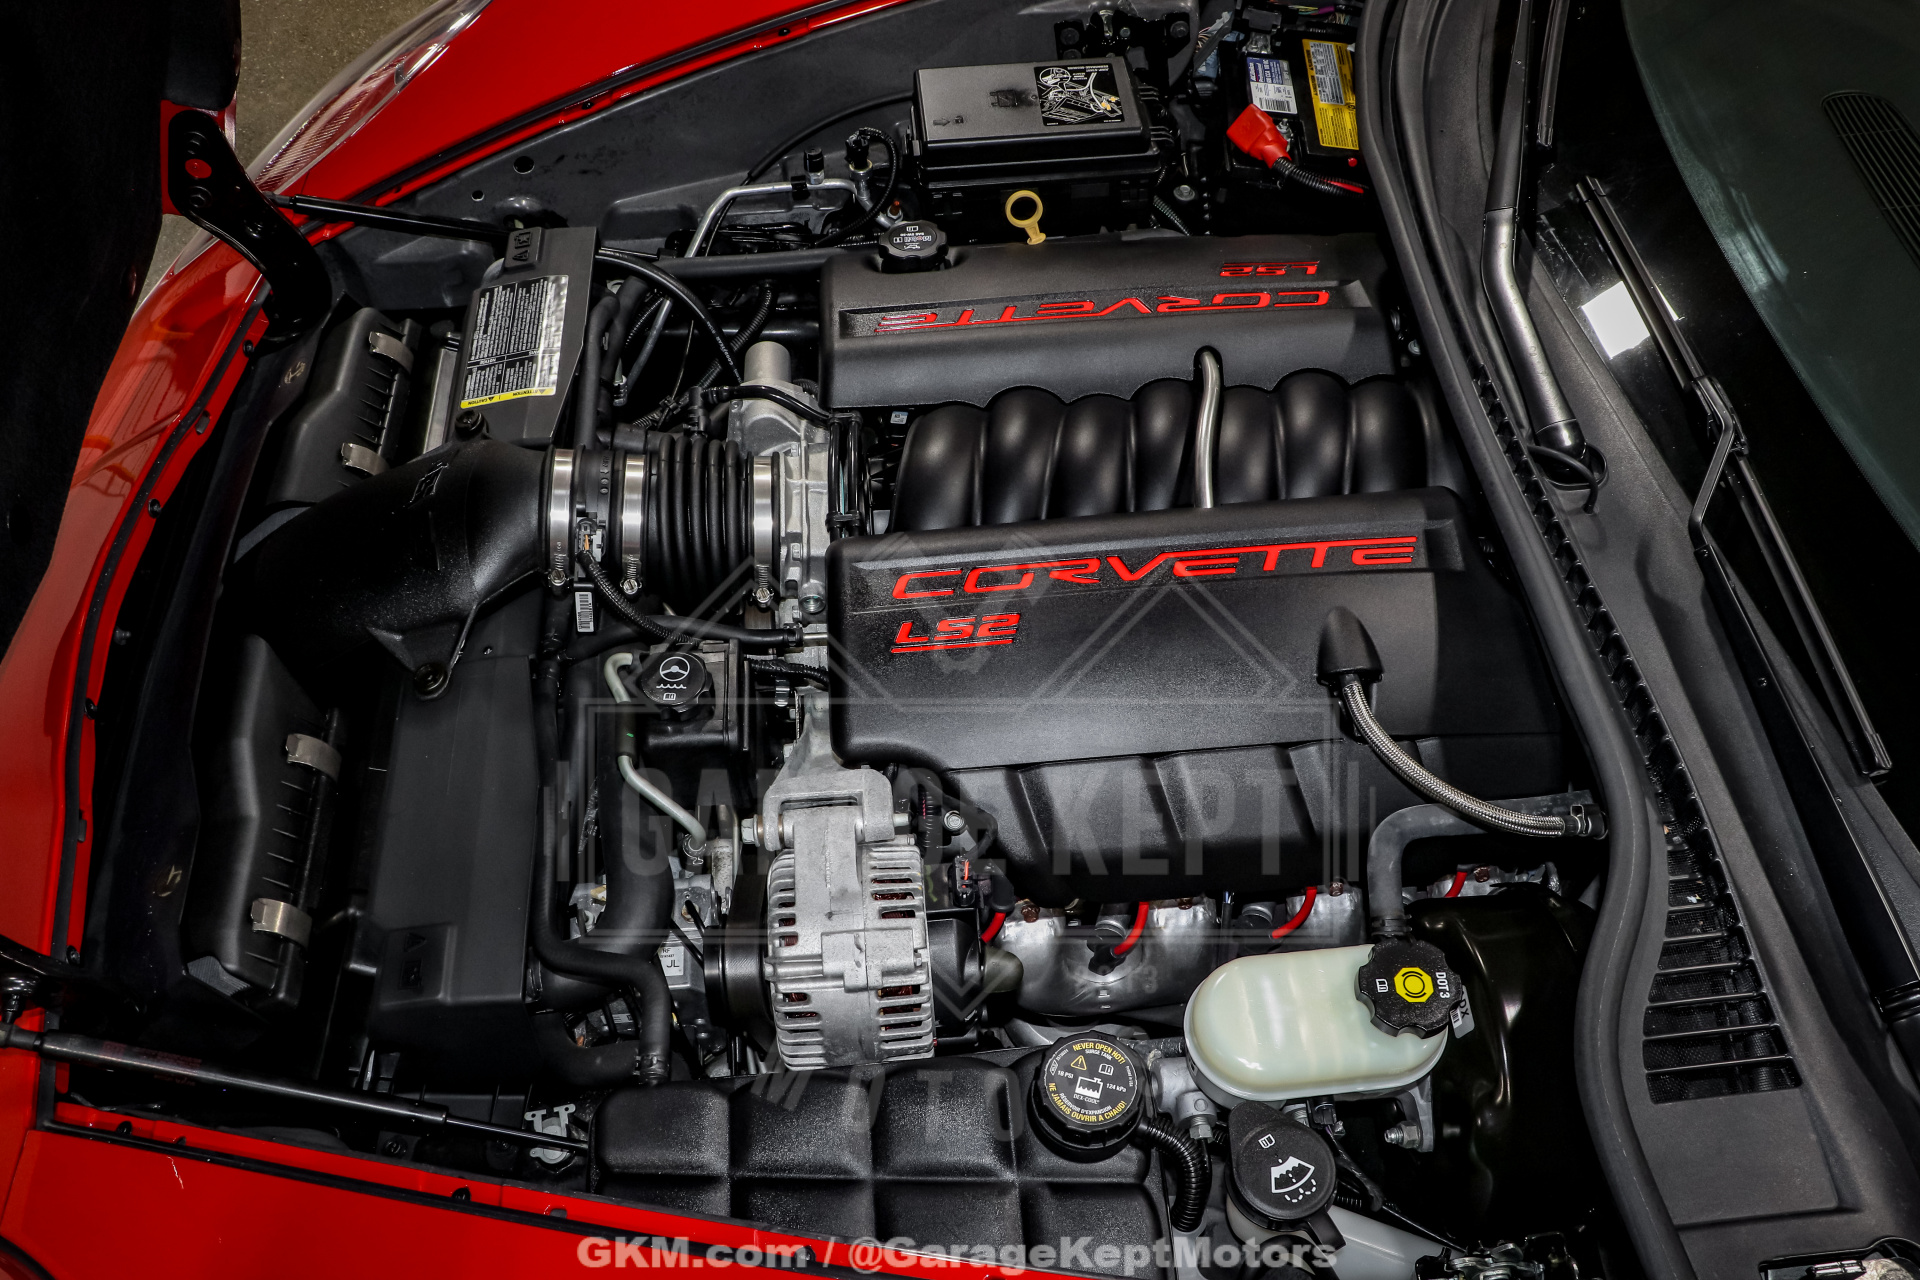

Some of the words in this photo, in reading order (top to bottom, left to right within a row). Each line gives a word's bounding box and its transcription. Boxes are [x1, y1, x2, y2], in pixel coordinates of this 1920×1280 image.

[1220, 261, 1320, 277] LS2
[874, 290, 1330, 333] CORVETTE
[468, 397, 488, 406] CAUTION
[891, 535, 1418, 601] CORVETTE
[892, 612, 1022, 651] LS2
[666, 959, 680, 968] JL
[1435, 972, 1449, 992] DOT
[1072, 1042, 1094, 1052] NEVER
[1095, 1042, 1112, 1053] OPEN
[1111, 1051, 1126, 1064] HOT!
[1100, 1052, 1113, 1060] TANK
[1048, 1082, 1057, 1092] NE
[1116, 1084, 1126, 1092] kPa
[1052, 1092, 1072, 1115] JAMAIS
[1104, 1100, 1127, 1120] CHAUD!
[1071, 1111, 1097, 1122] OUVRIR
[1098, 1114, 1104, 1122] A
